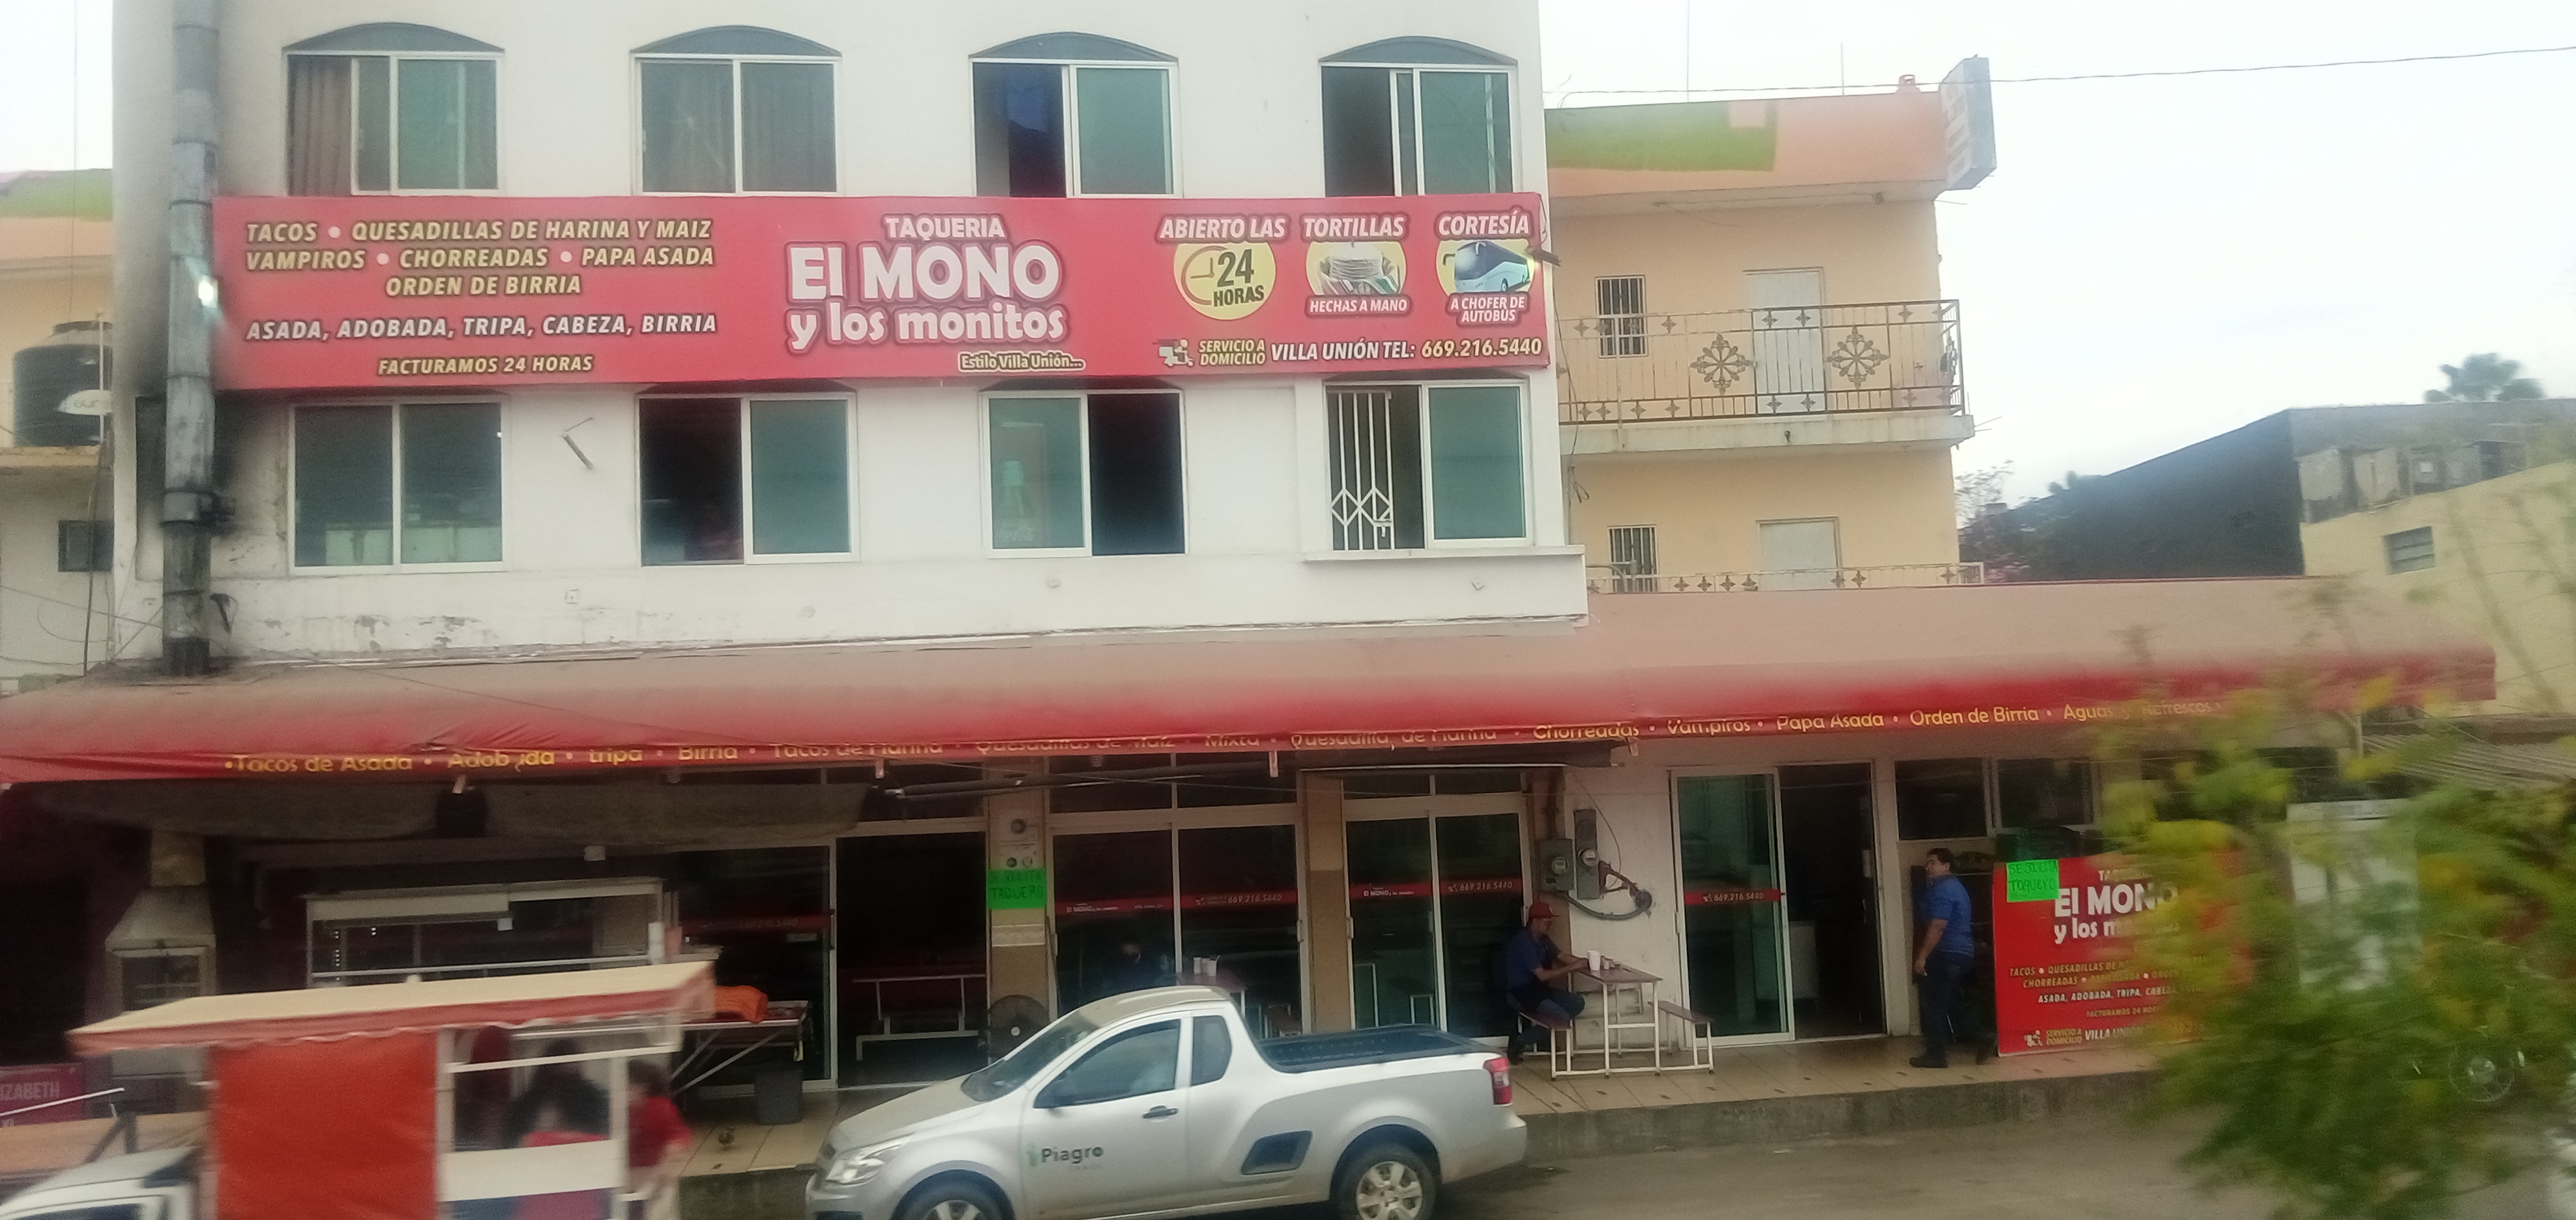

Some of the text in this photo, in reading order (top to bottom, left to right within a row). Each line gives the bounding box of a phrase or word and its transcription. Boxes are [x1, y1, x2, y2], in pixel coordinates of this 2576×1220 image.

[246, 219, 712, 243] TACOS QUESADILLAS DE HARINA Y MAIZ
[886, 218, 1005, 241] TAQUERIA
[1156, 216, 1286, 240] ABIERTO LAS
[1305, 215, 1405, 238] TORTILLAS
[1438, 211, 1530, 237] CORTESÍA
[246, 248, 714, 270] VAMPIROS CHORREADAS PAPA ASADA
[1217, 249, 1255, 288] 24
[789, 244, 1061, 300] El MONO
[385, 275, 582, 297] ORDEN DE BIRRIA
[1213, 285, 1265, 308] HORAS
[1310, 298, 1407, 313] HECHAS A MANO
[1450, 295, 1525, 310] A CHOFER DE
[244, 315, 718, 341] ASADA, ADOBADA, TRIPA, CABEZA, BIRRIA
[790, 302, 1064, 351] y los monitos
[1198, 340, 1265, 354] SERVICIO A
[1270, 338, 1543, 362] VILLA UNIÓN TEL: 669.216.5440
[378, 355, 593, 375] FACTURAMOS 24 HORAS
[961, 355, 997, 370] Estilo
[999, 354, 1029, 369] Villa
[1200, 353, 1266, 366] DOMICILIO
[233, 755, 298, 773] Tacos
[304, 755, 334, 772] de
[341, 755, 413, 772] Asada
[447, 750, 555, 774] Adobda
[678, 746, 738, 761] Birria
[772, 745, 830, 759] Tacos
[1534, 721, 1640, 740] Chorreadas
[1667, 718, 1752, 736] Vampiros
[1777, 715, 1825, 733] Papa
[1830, 712, 1885, 729] Asada
[1910, 708, 1963, 727] Orden
[1967, 707, 1989, 725] de
[1993, 705, 2040, 723] Birria
[2063, 703, 2113, 723] Aguas
[2008, 863, 2023, 875] SE
[1459, 881, 1512, 892] 669.216.5440
[1714, 892, 1764, 901] 669.216.5440
[1227, 893, 1282, 904] 669.216.5440
[2087, 882, 2179, 916] MONO
[2054, 924, 2067, 944] y
[2072, 918, 2098, 939] los
[2010, 967, 2036, 977] TACOS
[2047, 961, 2104, 975] QUESADILLAS
[2105, 961, 2116, 970] DE
[2023, 976, 2079, 989] CHORREADAS
[2086, 1007, 2130, 1019] FACTURAMOS
[2085, 1028, 2111, 1041] VILLA
[1042, 1146, 1105, 1165] Piagro
